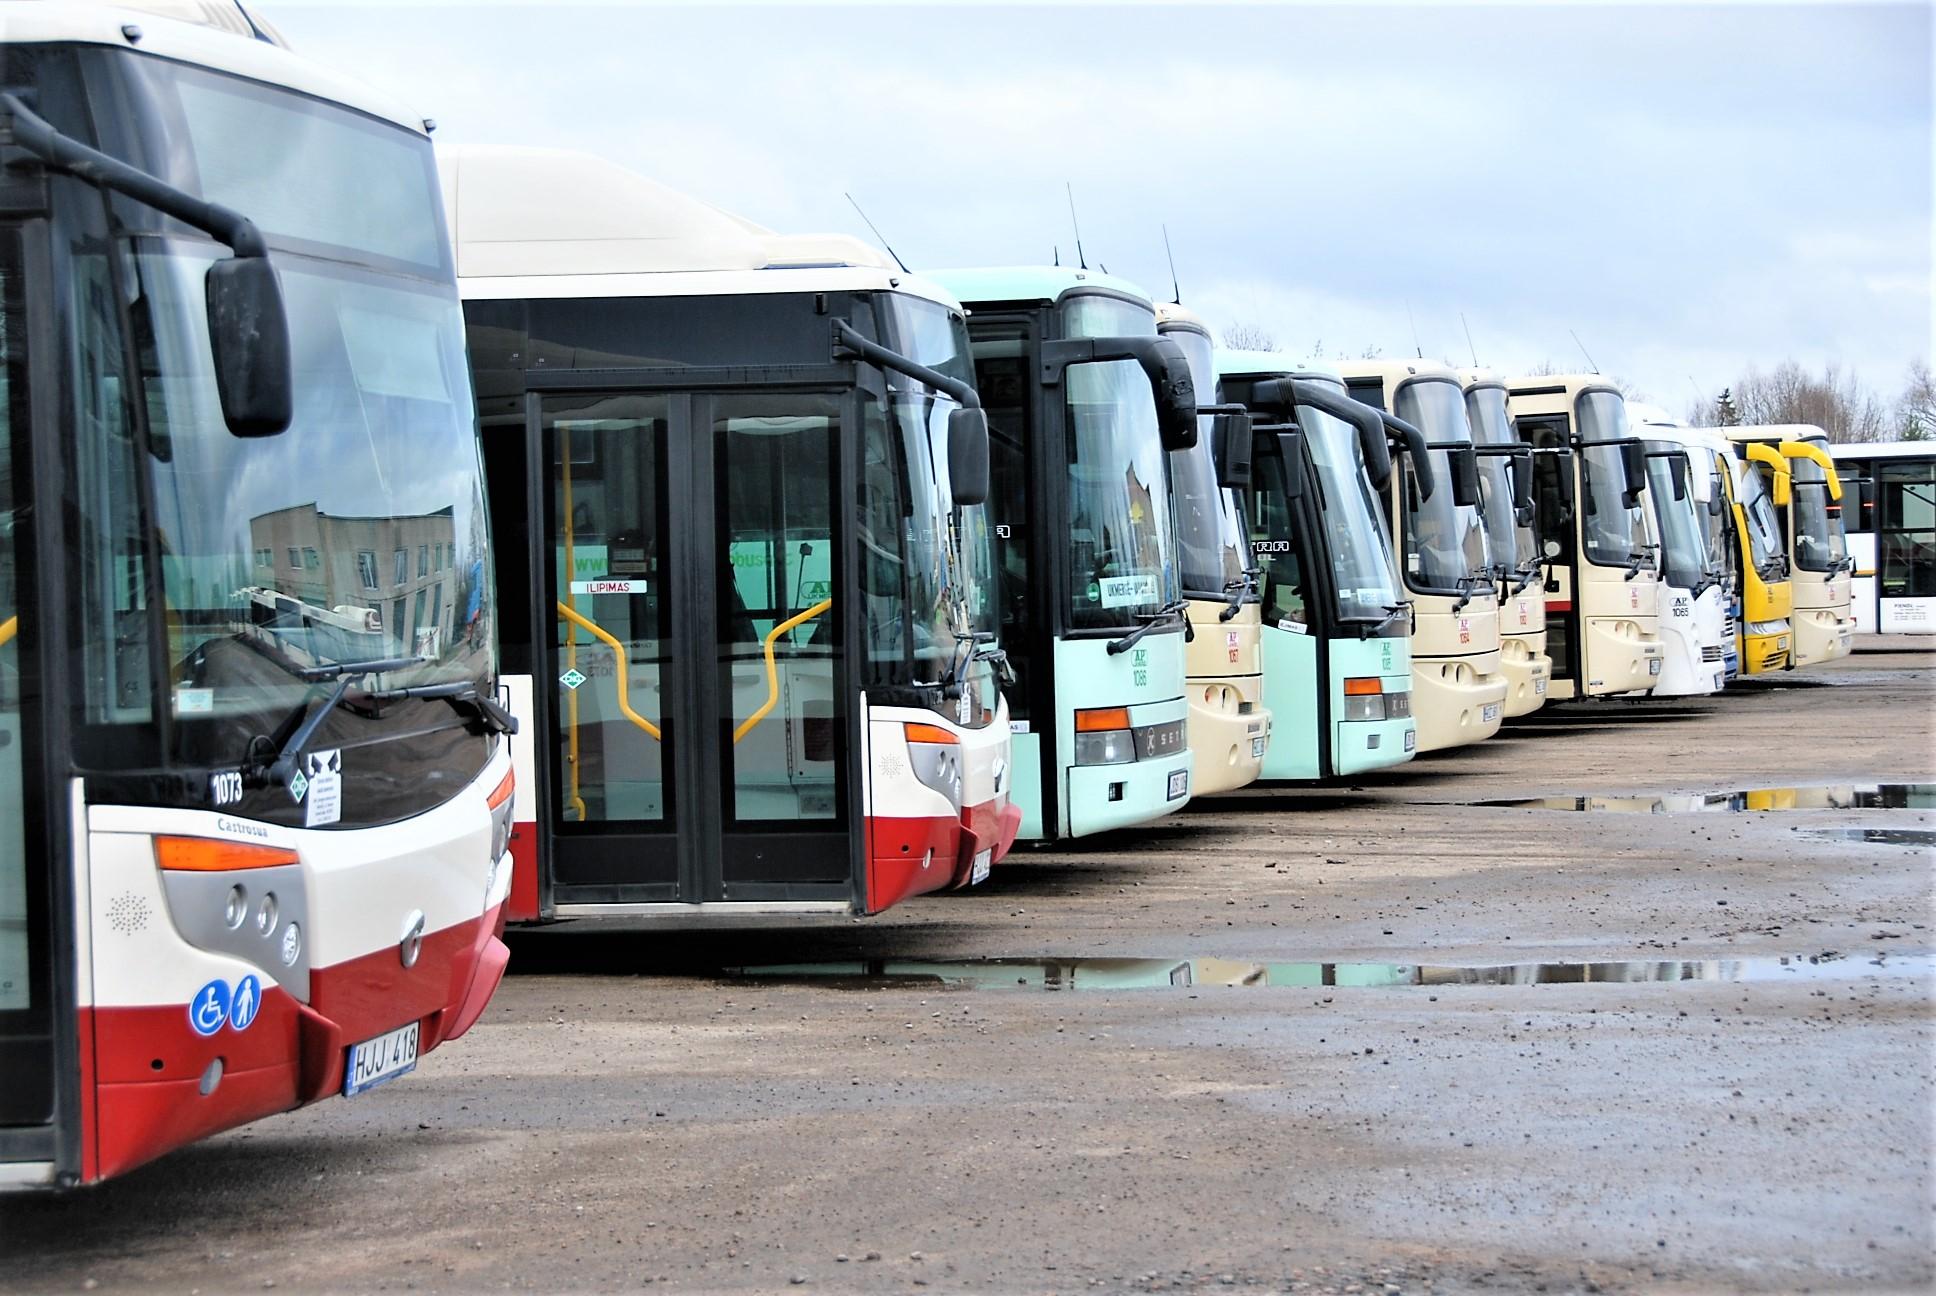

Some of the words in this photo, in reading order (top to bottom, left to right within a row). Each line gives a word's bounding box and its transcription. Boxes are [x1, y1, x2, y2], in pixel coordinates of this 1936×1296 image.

[212, 773, 243, 804] 1073
[217, 817, 269, 838] Castrosua
[355, 1039, 387, 1082] HJJ
[392, 1027, 416, 1065] 418
